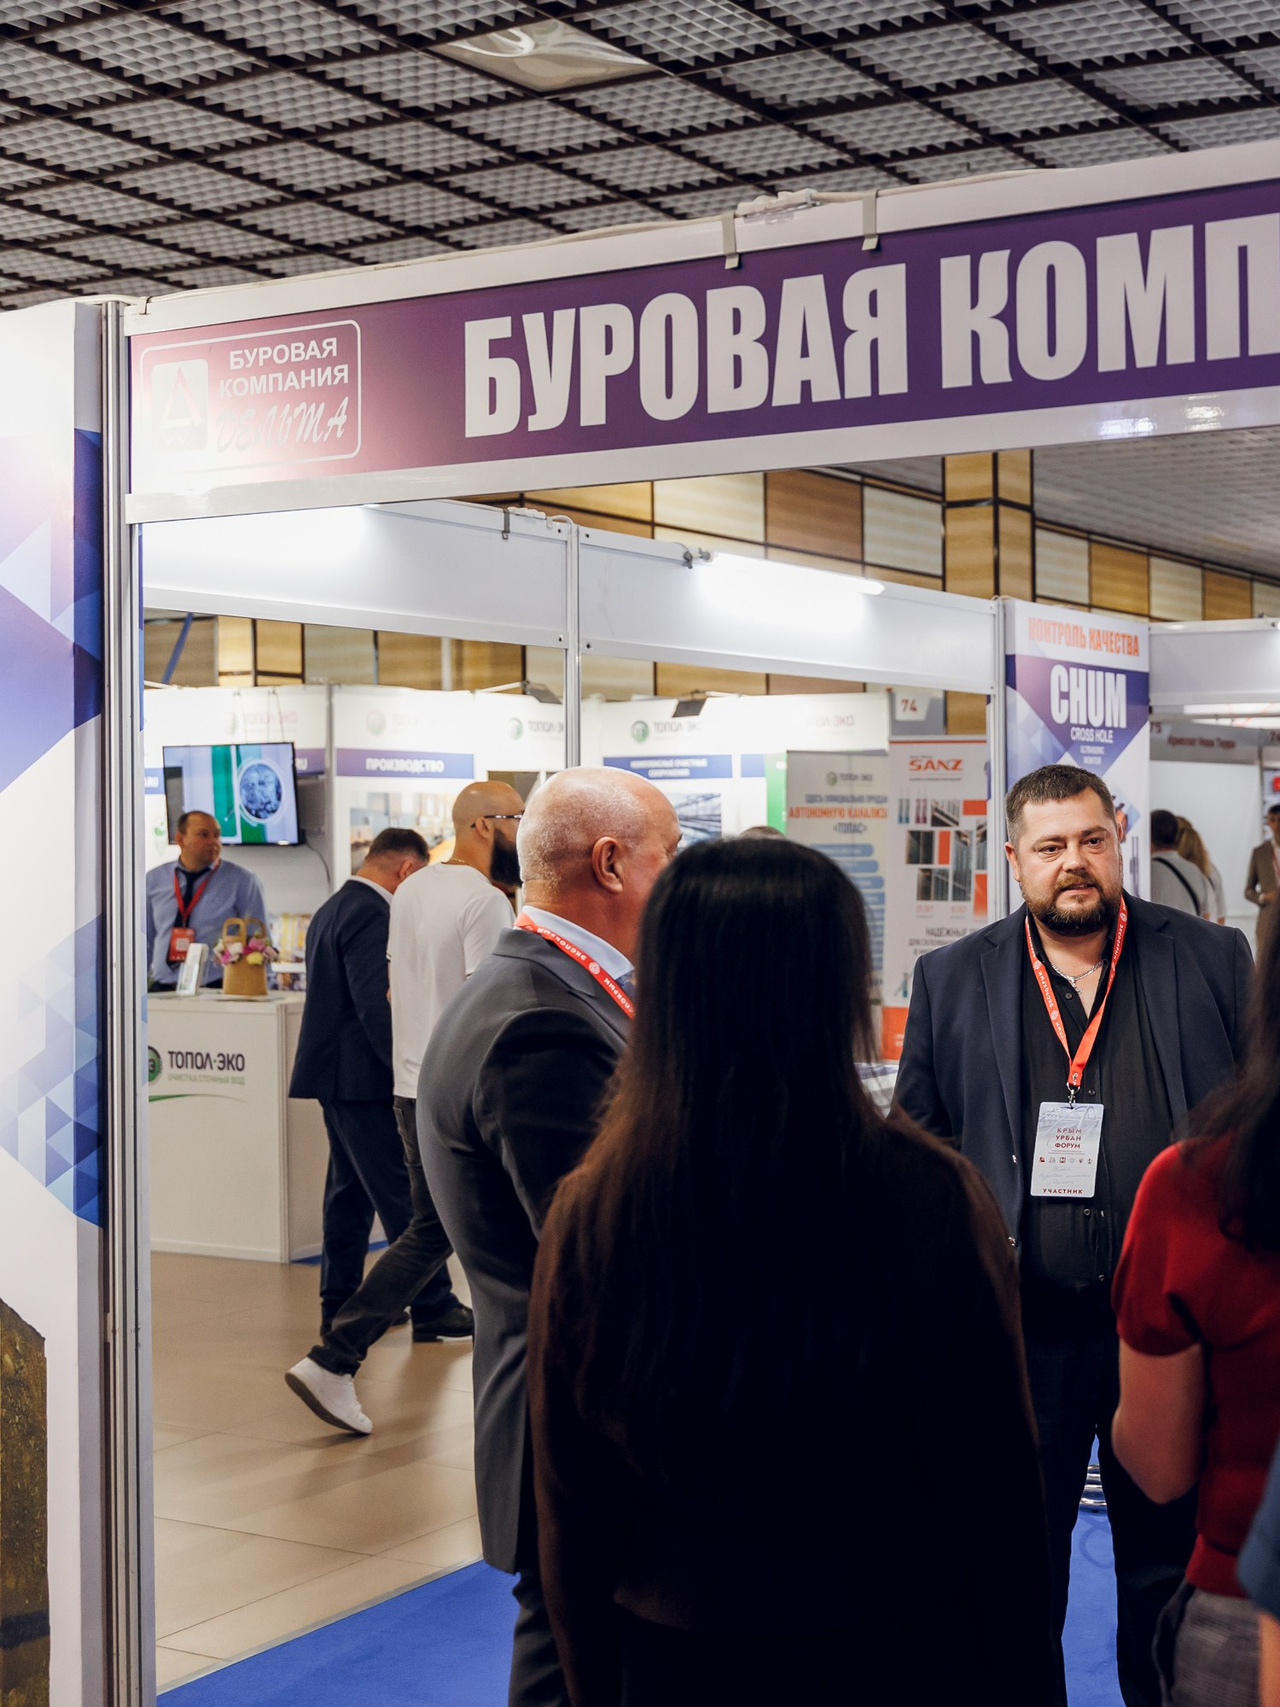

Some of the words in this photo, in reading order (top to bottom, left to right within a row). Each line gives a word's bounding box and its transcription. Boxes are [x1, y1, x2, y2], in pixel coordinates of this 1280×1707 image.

[229, 337, 338, 370] БУРОВАЯ
[464, 263, 909, 438] БУРОВАЯ
[219, 363, 349, 398] КОМПАНИЯ
[1027, 617, 1086, 649] КОНТРОЛЬ
[1088, 628, 1140, 657] КАЧЕСТВА
[901, 698, 917, 712] 74
[1050, 663, 1128, 729] CHUM
[1070, 727, 1095, 742] CROSS
[1095, 729, 1114, 744] HOLE
[365, 757, 445, 775] ПРОИЗВОДСТВО
[909, 758, 963, 772] SANZ
